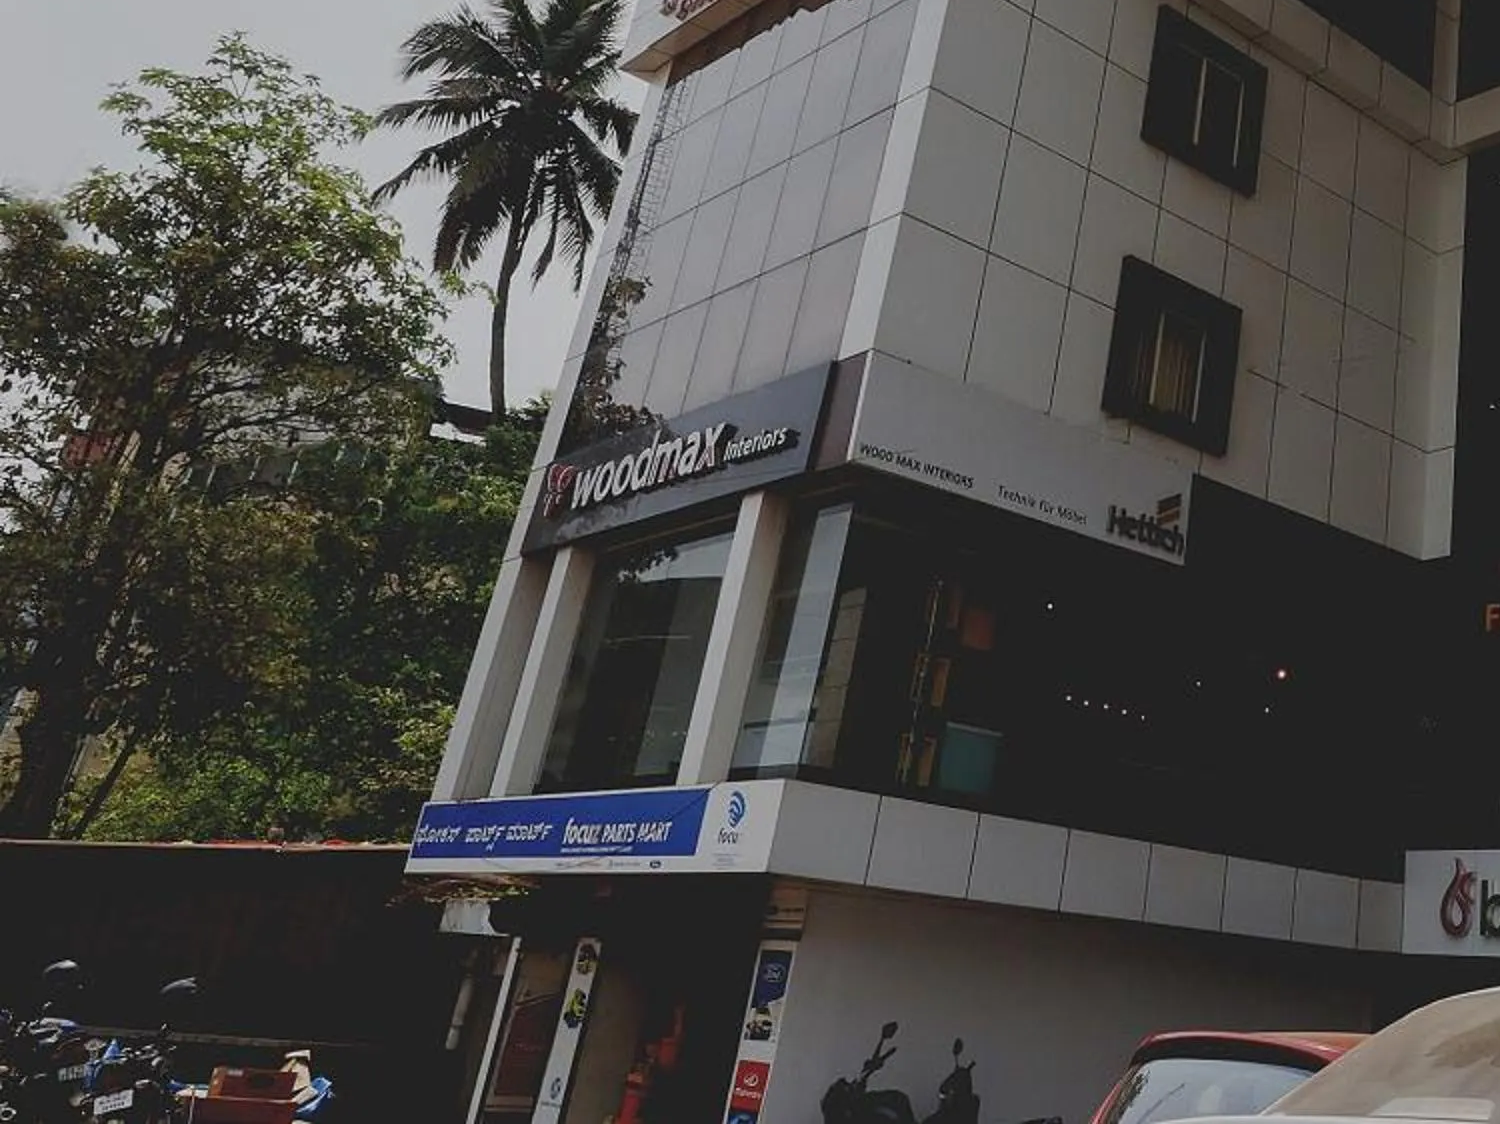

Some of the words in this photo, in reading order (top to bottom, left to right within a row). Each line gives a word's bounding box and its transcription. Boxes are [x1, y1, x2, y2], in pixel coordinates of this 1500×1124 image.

[861, 444, 893, 462] WOOD
[896, 456, 920, 472] MAX
[923, 464, 974, 488] INTERIORS
[602, 823, 636, 844] PARTS
[636, 821, 673, 843] MART
